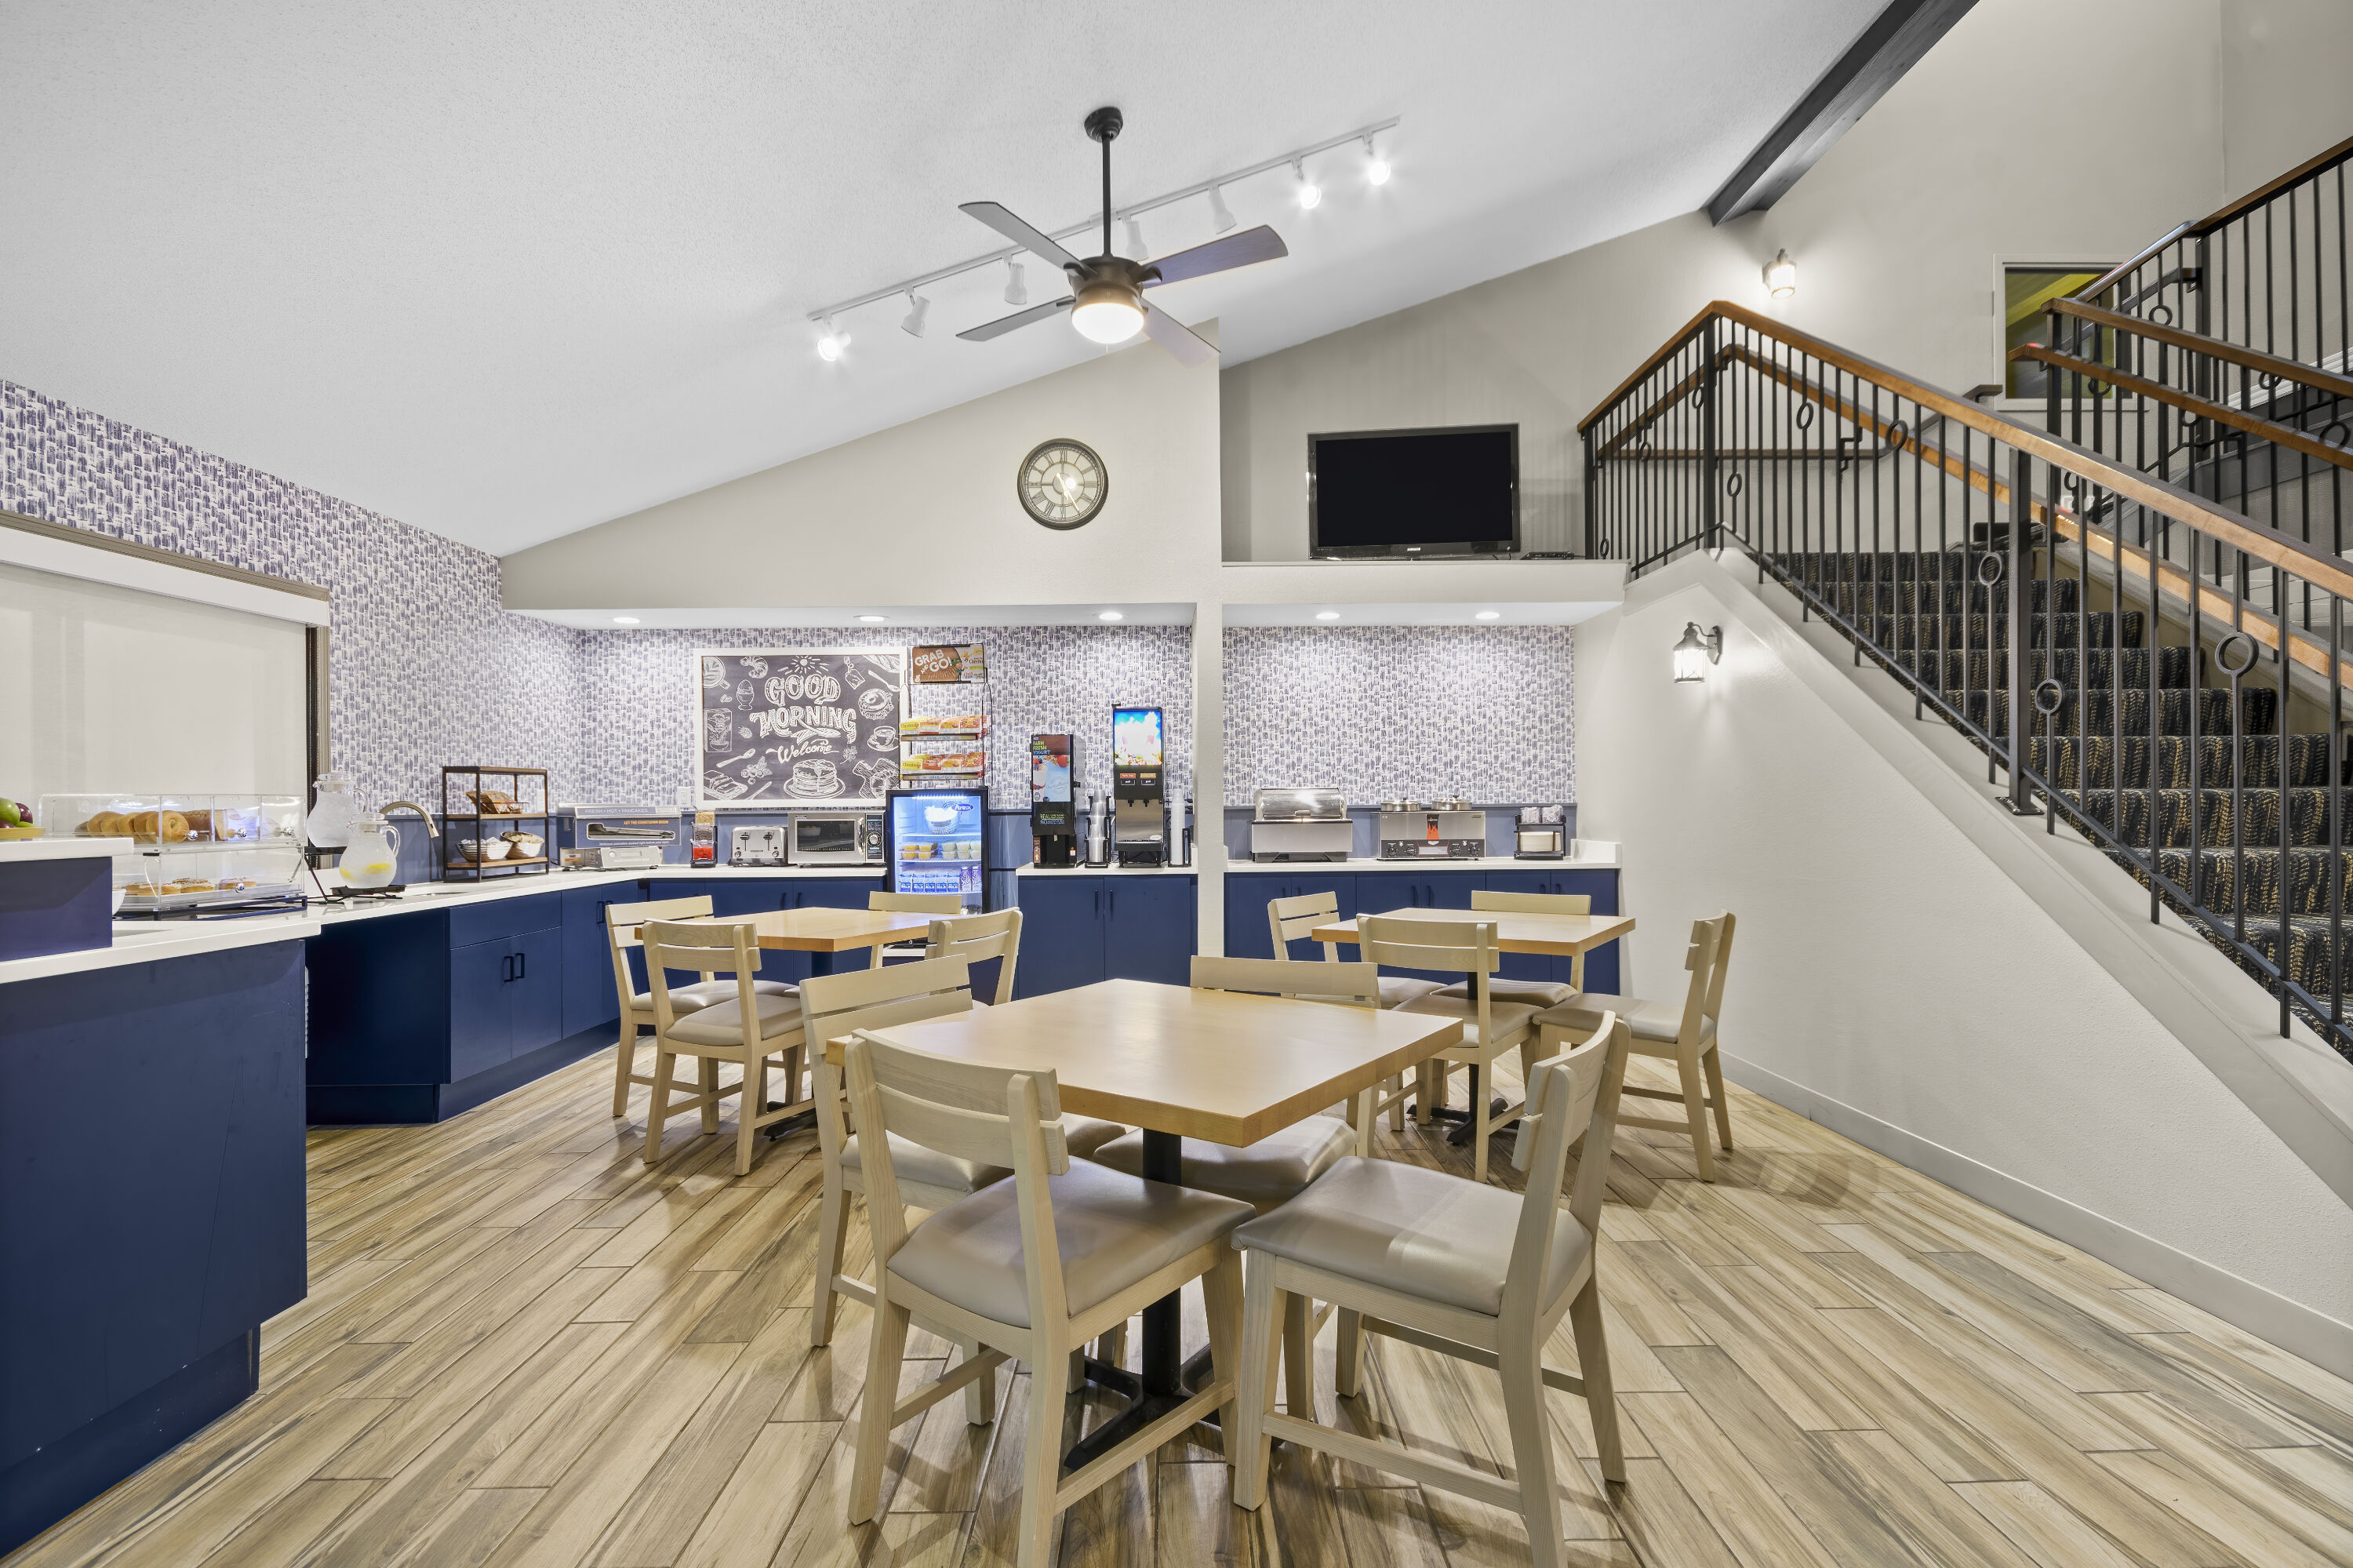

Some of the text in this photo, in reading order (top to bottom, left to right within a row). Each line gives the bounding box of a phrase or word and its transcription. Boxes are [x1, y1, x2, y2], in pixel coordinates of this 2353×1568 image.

[915, 649, 944, 666] GRAB
[929, 657, 953, 672] GO!
[764, 674, 842, 707] GOOD
[749, 706, 857, 745] MORNING
[766, 740, 840, 764] Welcome
